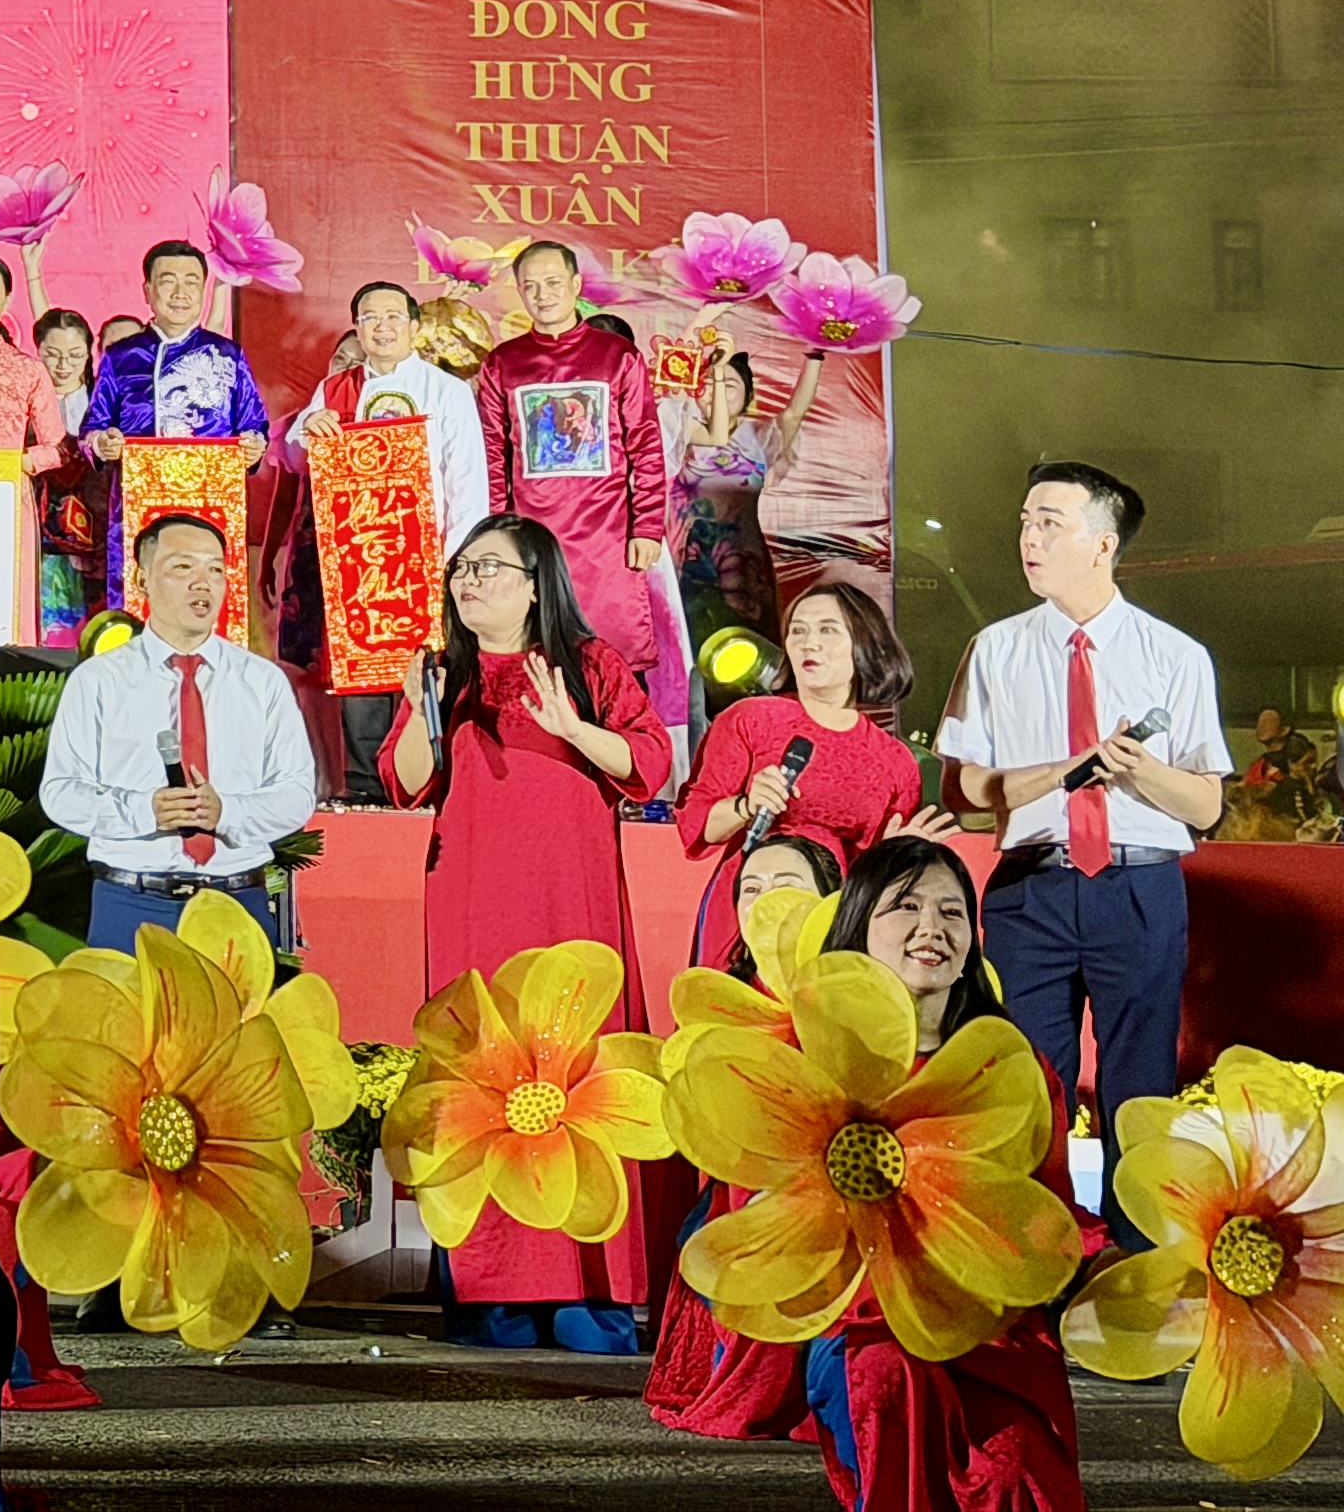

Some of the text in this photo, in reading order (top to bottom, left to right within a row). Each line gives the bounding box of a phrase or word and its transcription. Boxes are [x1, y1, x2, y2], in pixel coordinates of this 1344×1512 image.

[470, 54, 655, 103] HƯNG
[455, 118, 672, 174] THUẬN
[471, 172, 644, 226] XUÂN
